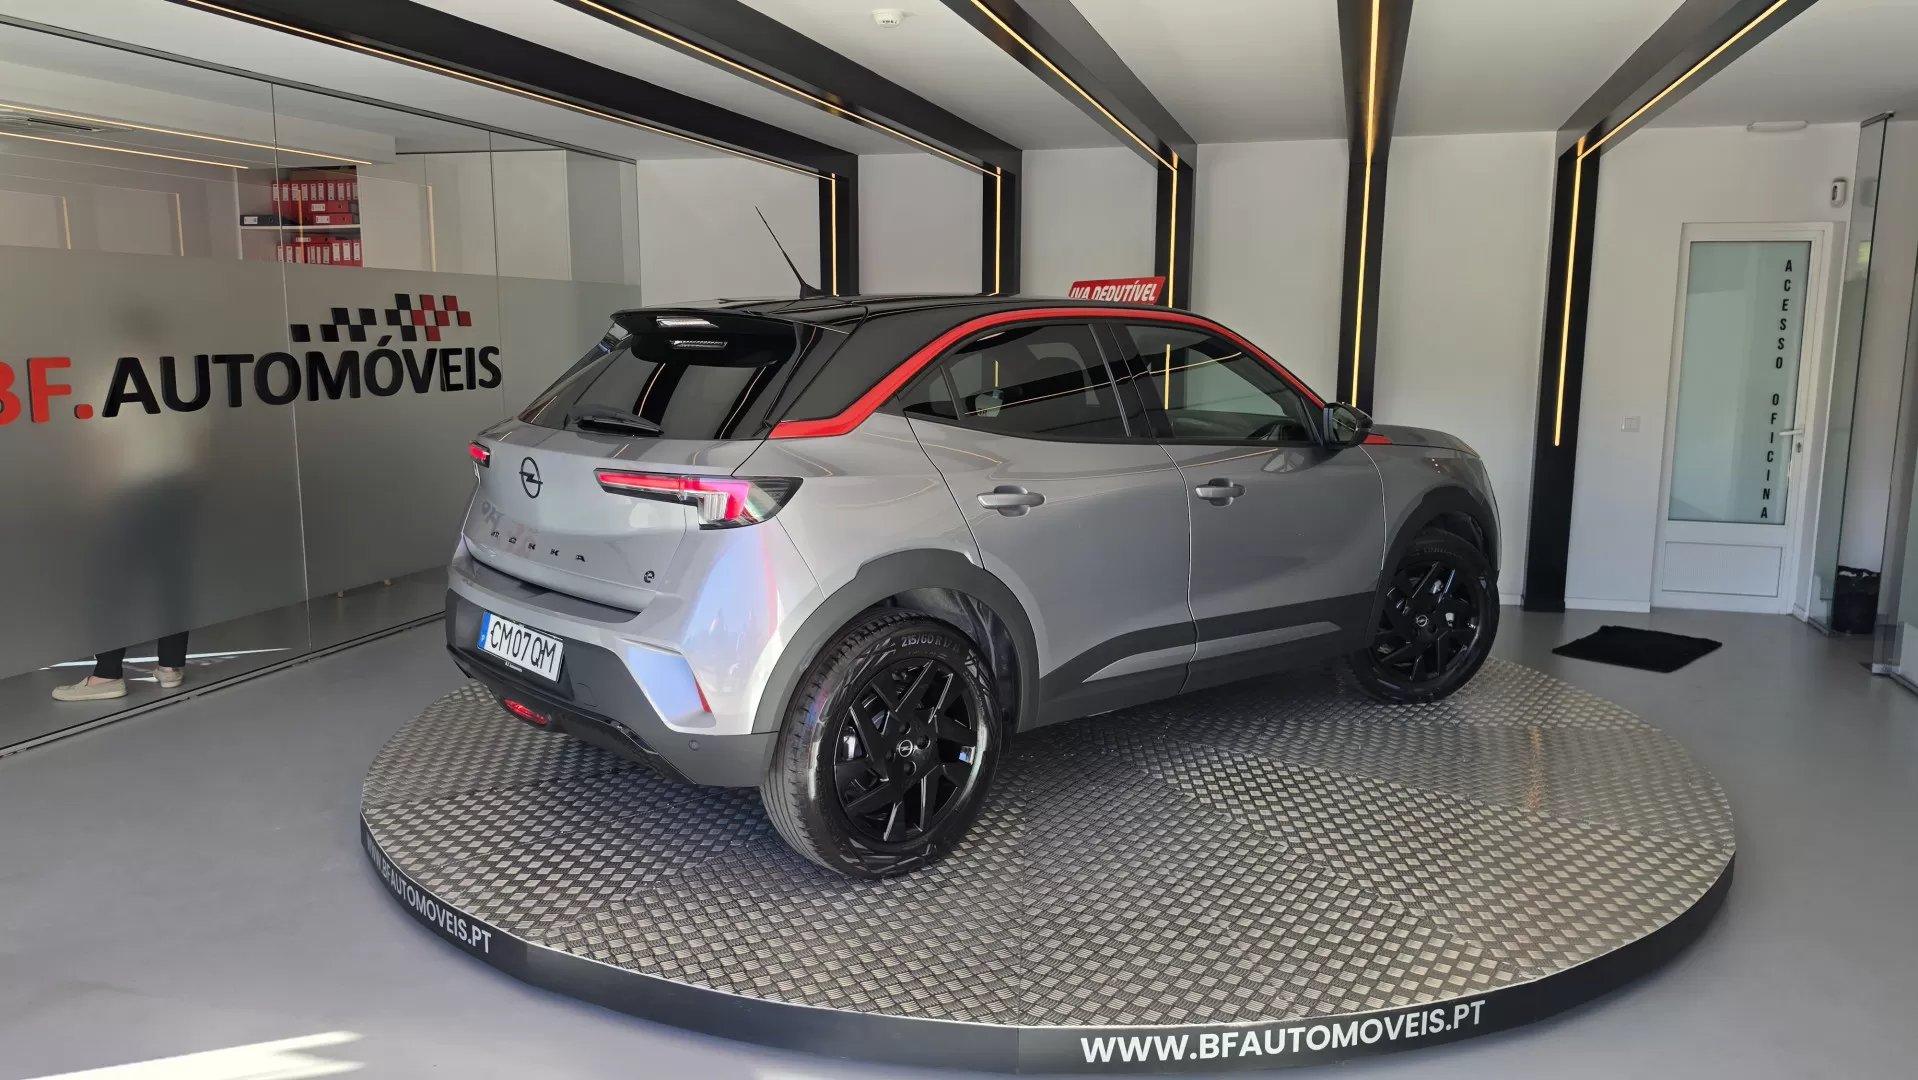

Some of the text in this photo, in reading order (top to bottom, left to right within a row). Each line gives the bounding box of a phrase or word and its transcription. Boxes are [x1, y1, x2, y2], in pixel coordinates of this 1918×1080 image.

[1070, 280, 1157, 302] IVA DEDUTÍVEL
[1760, 259, 1793, 519] ACESSO OFICINA
[490, 531, 586, 562] MOKKA
[901, 633, 934, 647] 215/60
[1080, 1000, 1486, 1064] WWW.BFAUTOMOVEIS.PT
